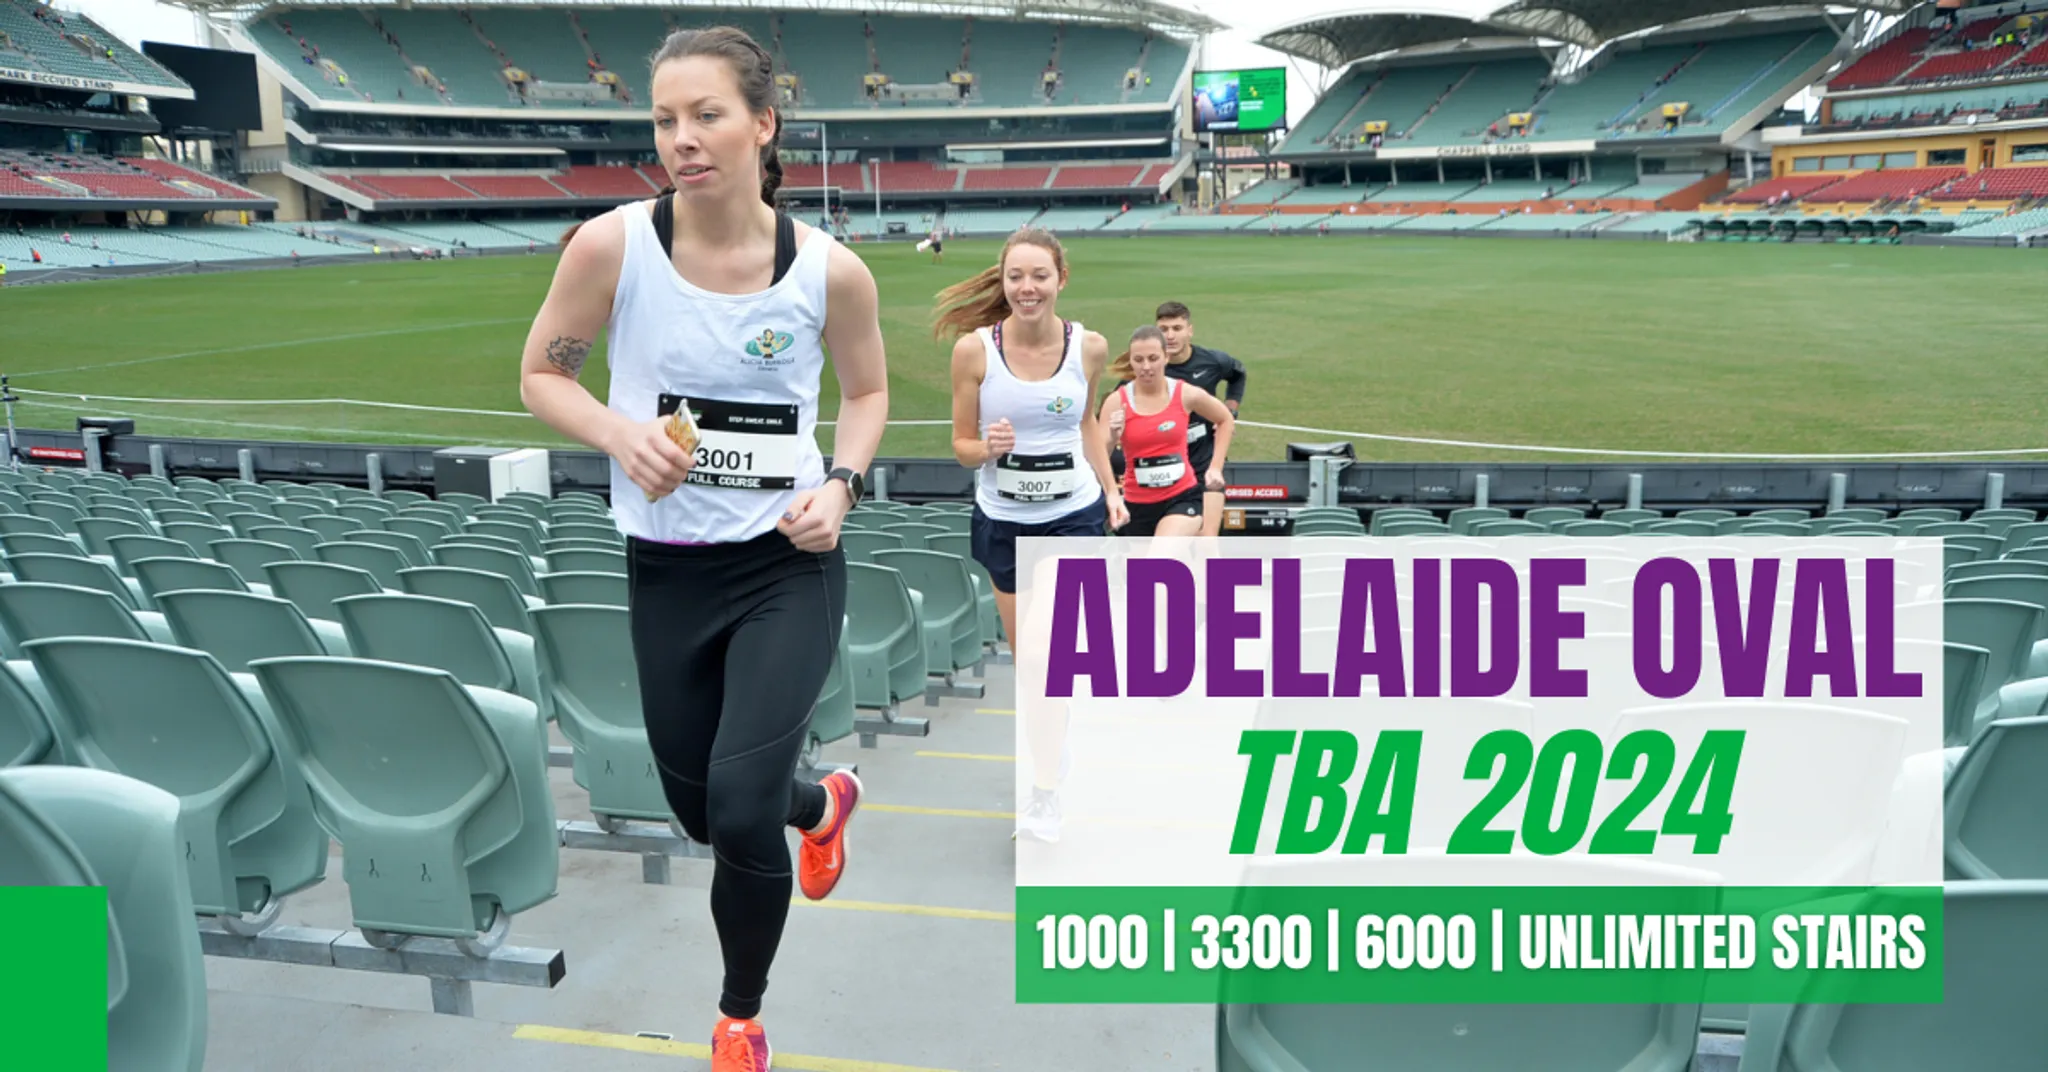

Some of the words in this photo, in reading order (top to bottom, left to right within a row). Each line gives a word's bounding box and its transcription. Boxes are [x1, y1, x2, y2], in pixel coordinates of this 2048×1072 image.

[83, 80, 114, 90] STAND
[1436, 145, 1490, 157] CHAPPELL
[1496, 143, 1531, 155] STAND
[695, 447, 753, 471] 3001
[687, 472, 715, 485] FULL
[718, 476, 761, 488] COURSE
[1017, 480, 1052, 492] 3007
[1254, 487, 1284, 497] ACCESS
